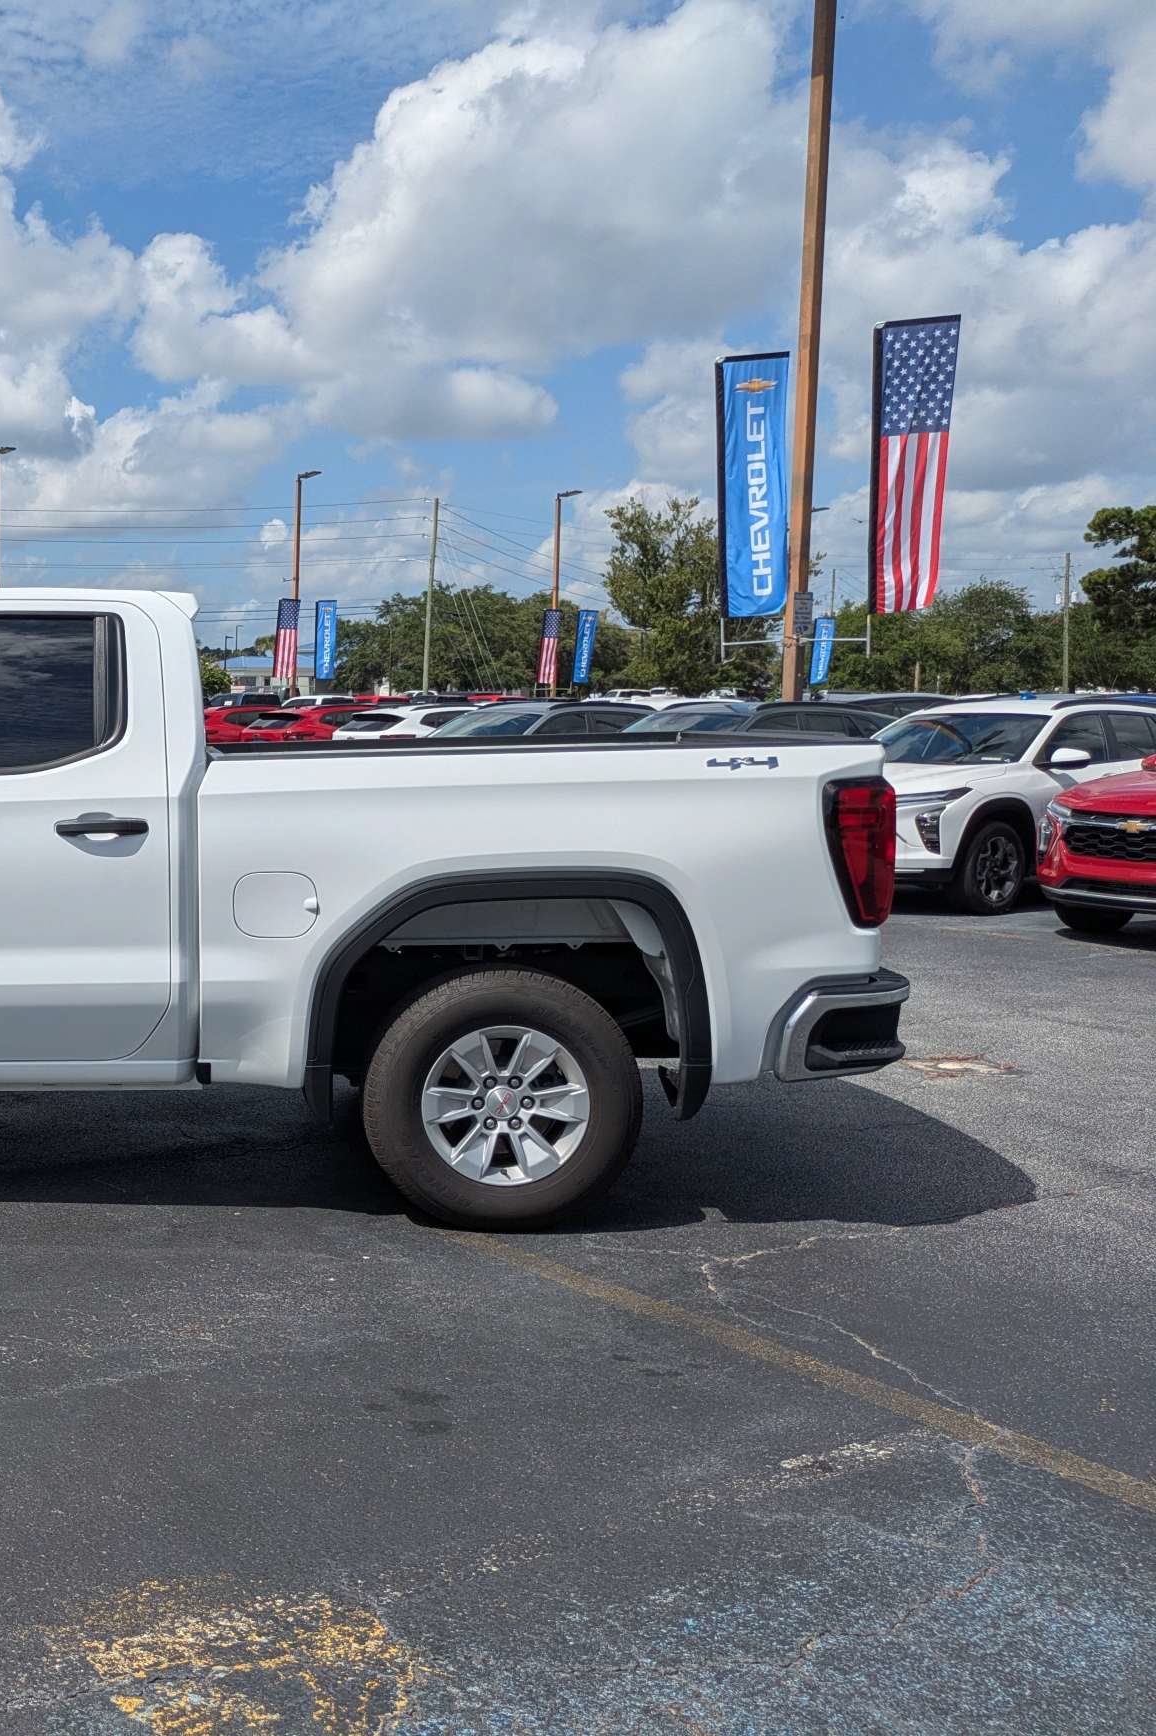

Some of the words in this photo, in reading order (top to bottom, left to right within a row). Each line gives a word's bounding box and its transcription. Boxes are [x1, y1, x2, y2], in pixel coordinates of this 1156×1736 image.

[747, 401, 773, 596] CHEVROLET
[323, 613, 331, 673] CHEVROLET
[580, 623, 590, 677] CHEVROLET
[817, 629, 828, 680] CHEVROLET
